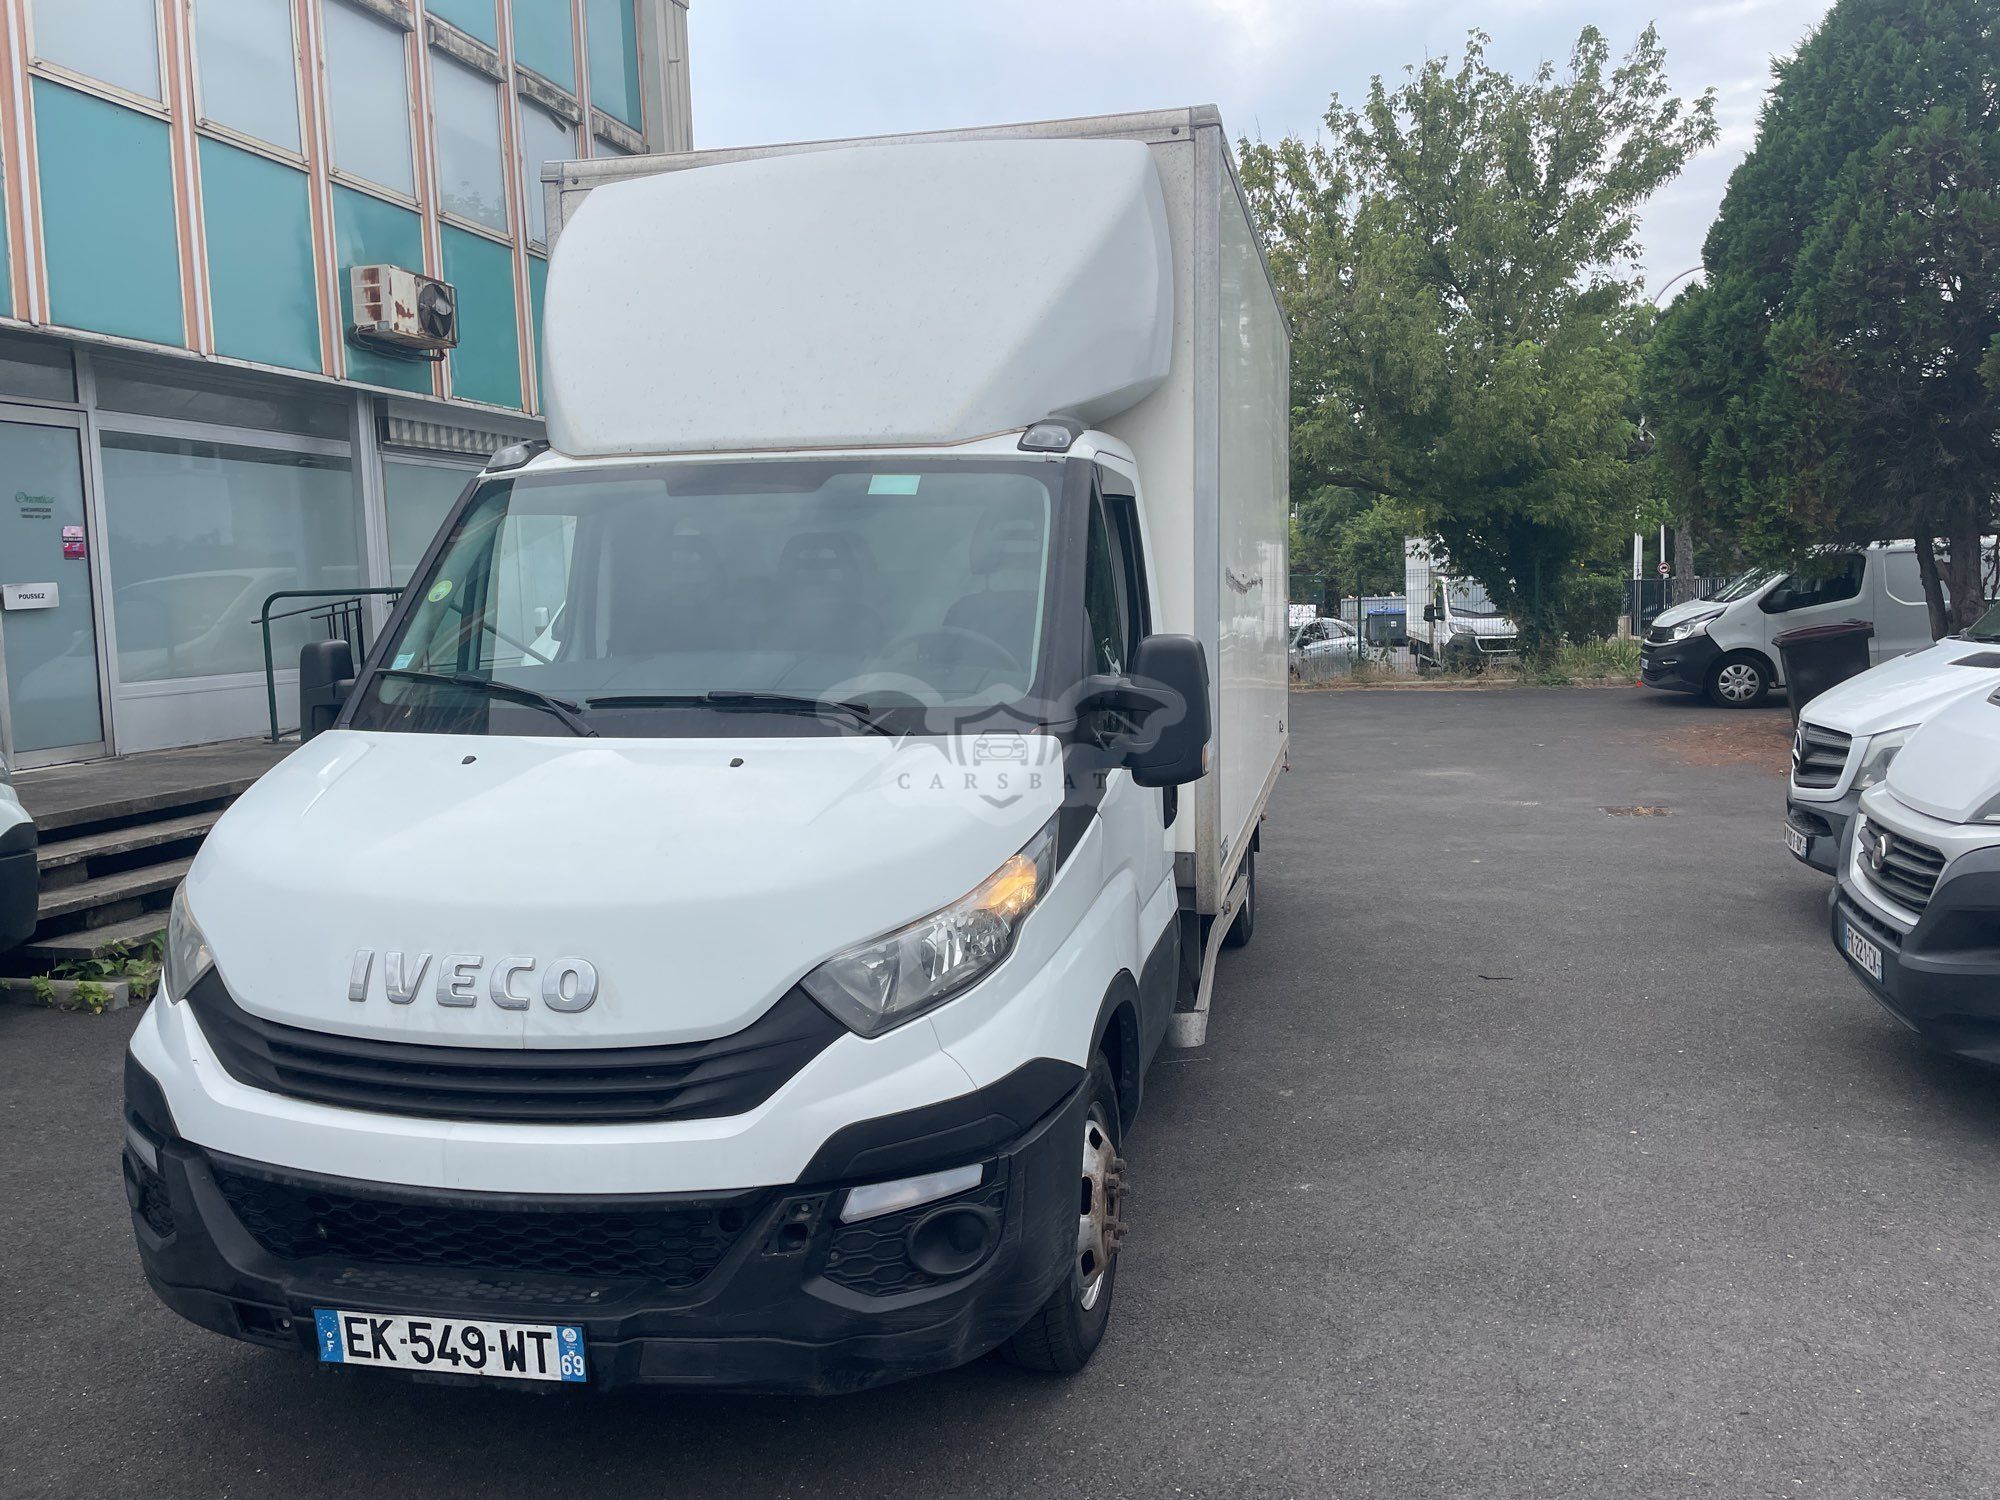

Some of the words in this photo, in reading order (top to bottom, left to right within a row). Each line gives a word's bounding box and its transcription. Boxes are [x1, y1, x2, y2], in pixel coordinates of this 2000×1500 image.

[348, 950, 599, 1013] IVECO
[326, 1340, 335, 1352] F
[343, 1316, 552, 1374] EK-549-WT
[561, 1354, 585, 1377] 69
